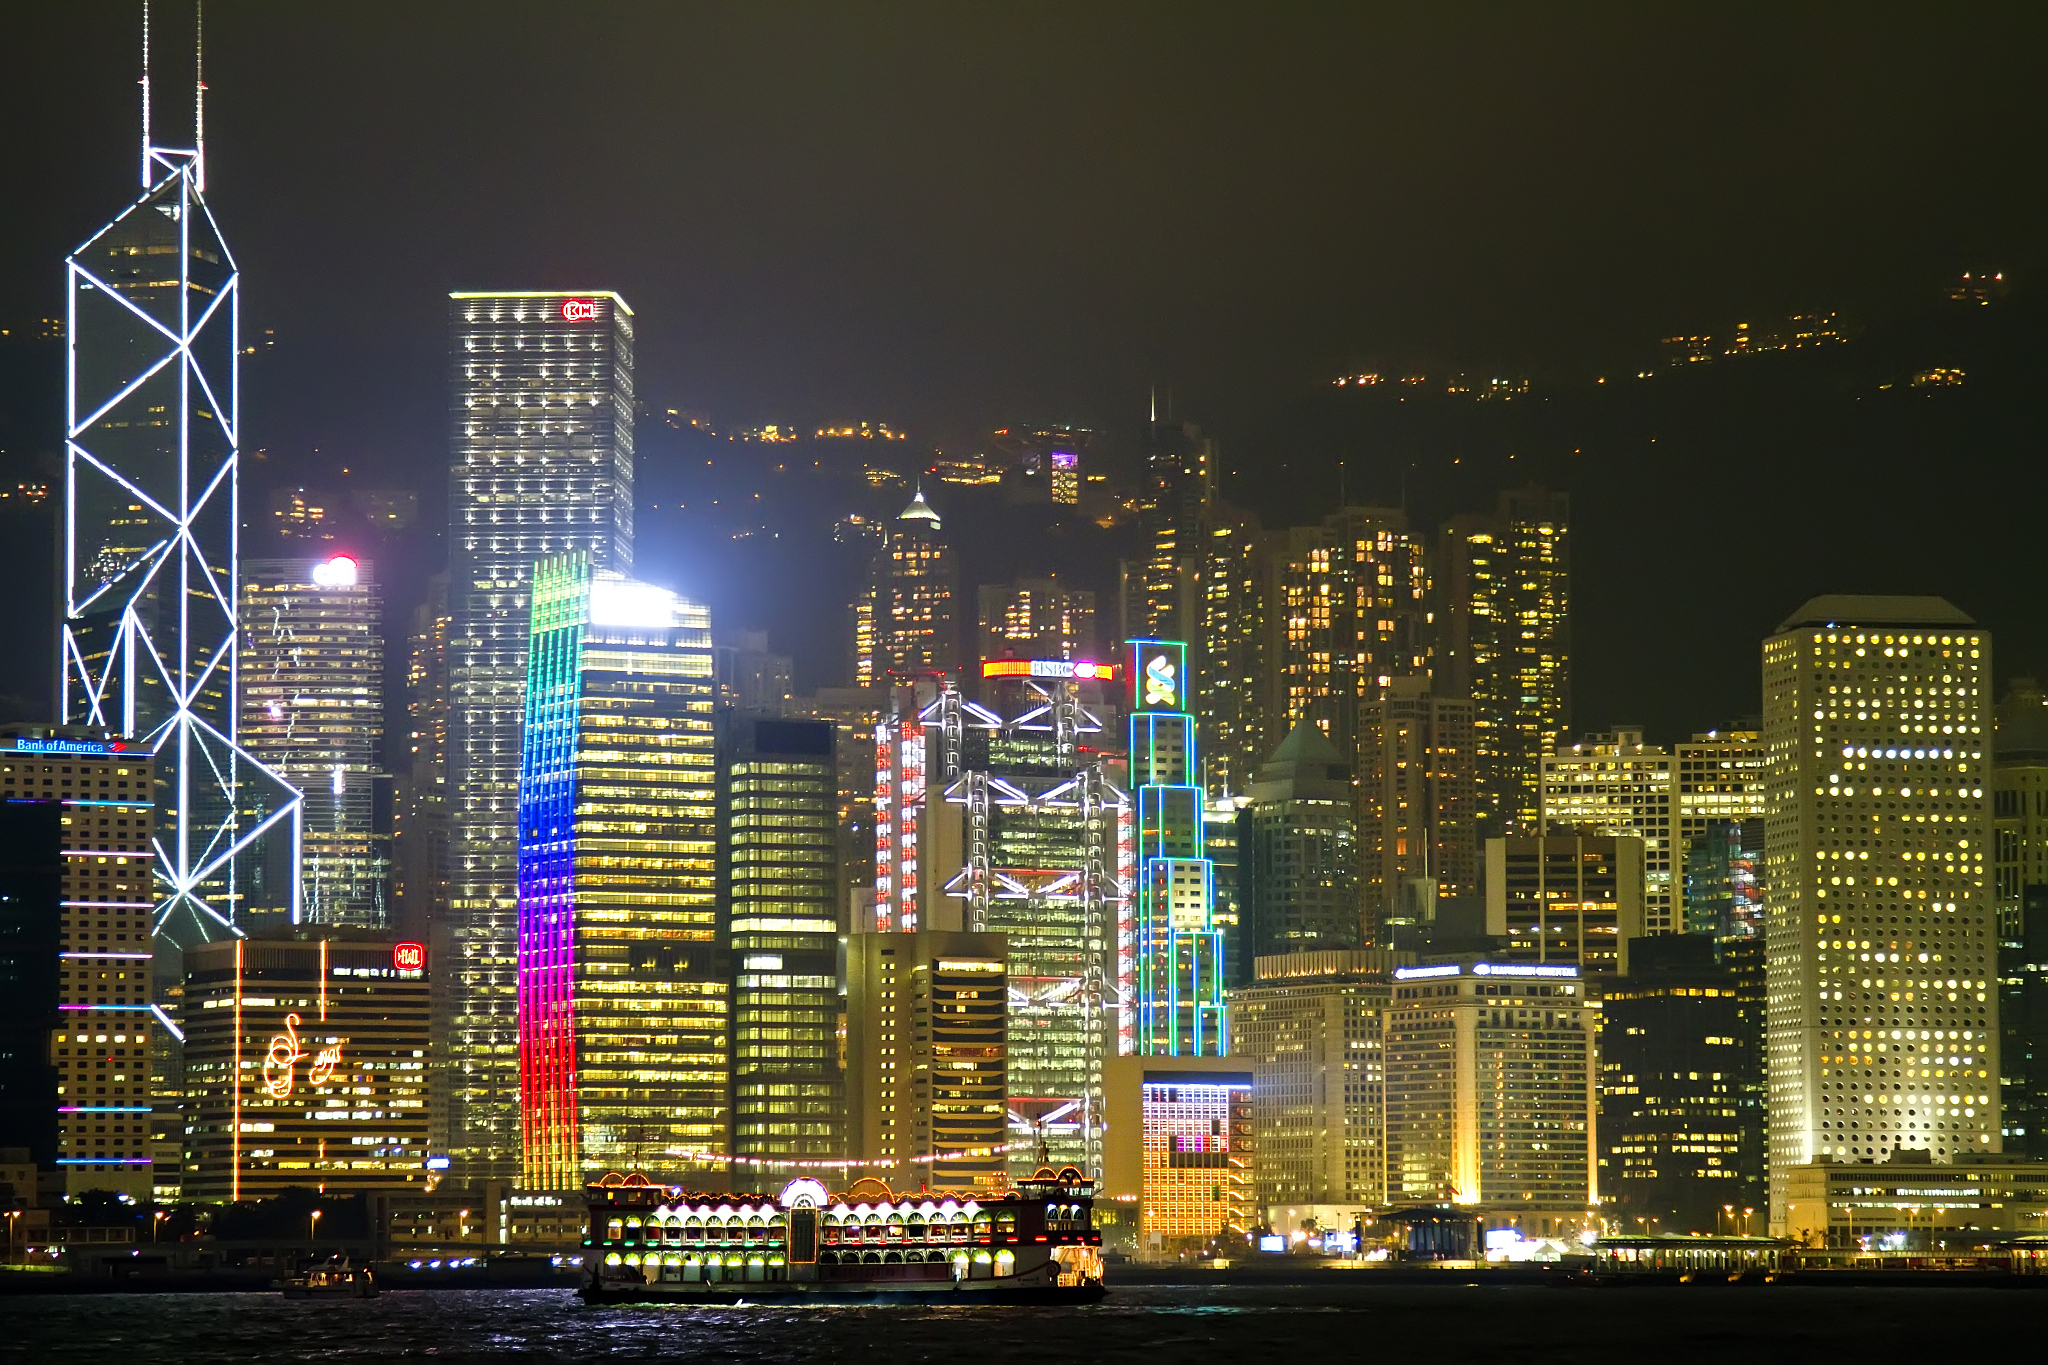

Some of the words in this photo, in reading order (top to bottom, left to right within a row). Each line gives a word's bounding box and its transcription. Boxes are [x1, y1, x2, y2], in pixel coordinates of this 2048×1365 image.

[1032, 661, 1073, 677] HSBC
[17, 739, 45, 750] Bank
[46, 740, 58, 751] of
[59, 741, 104, 752] America
